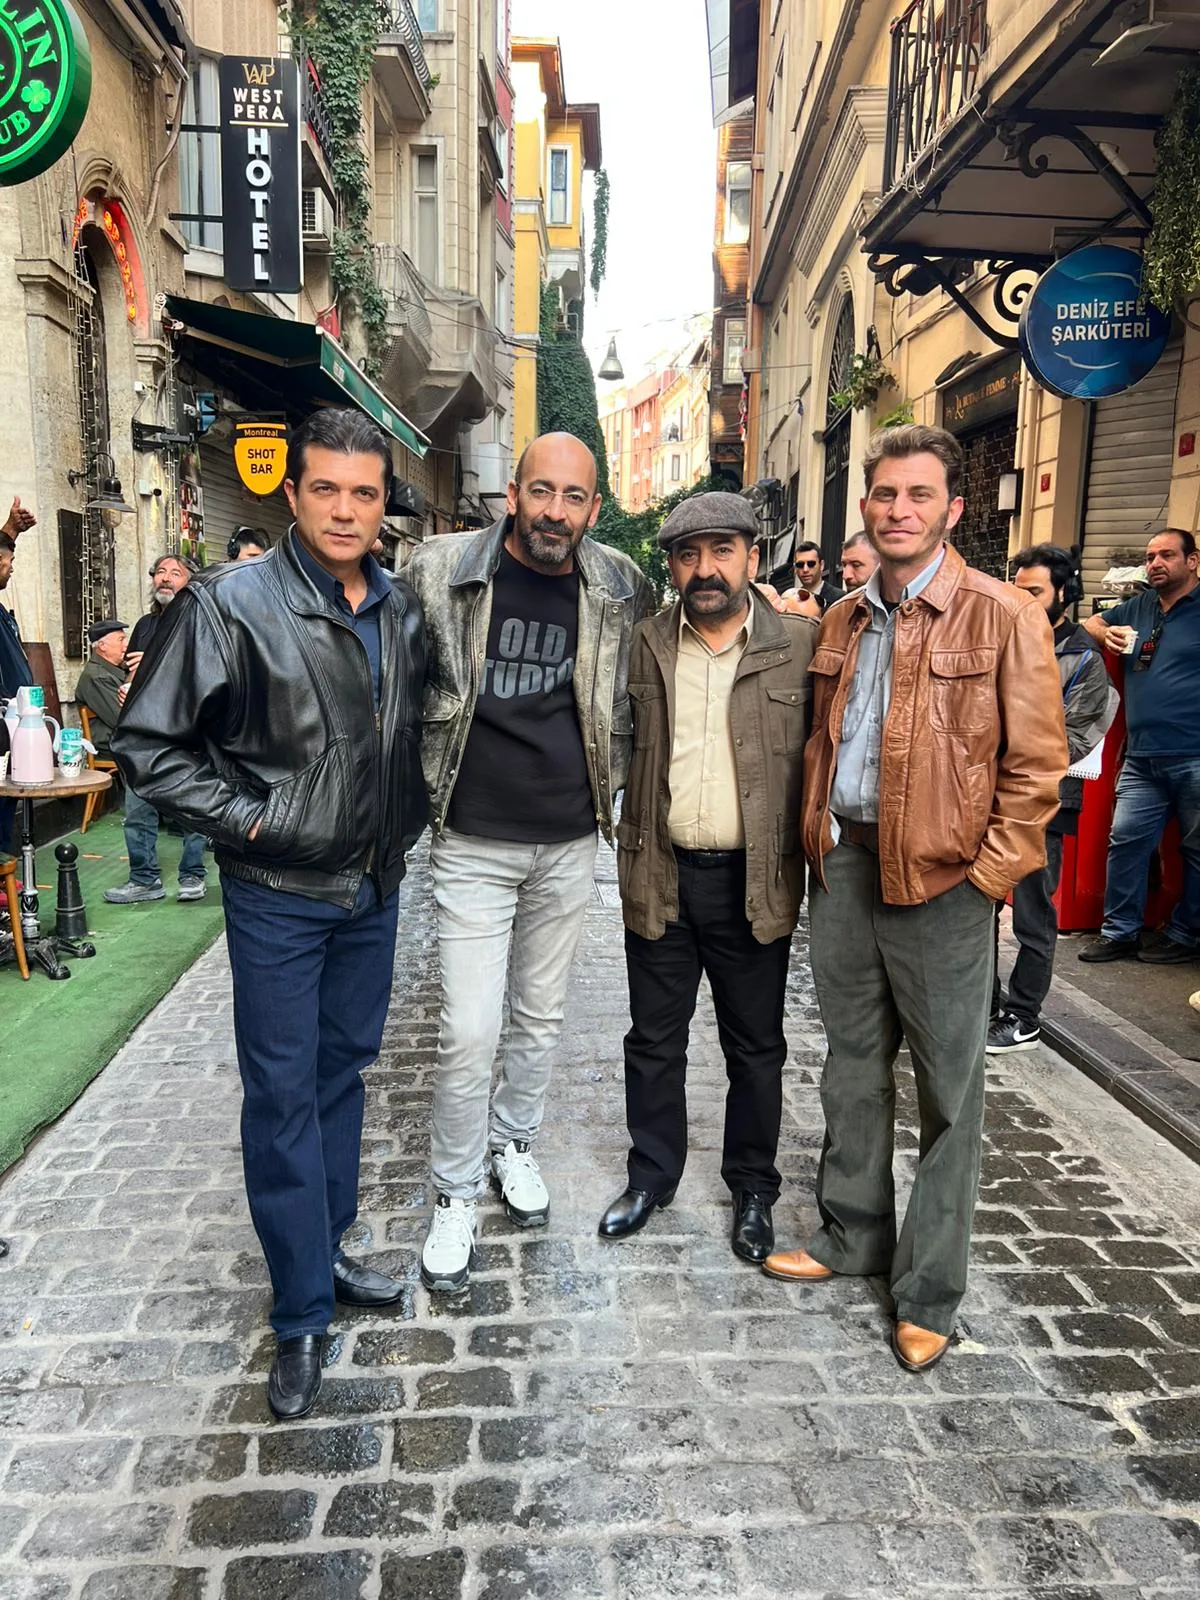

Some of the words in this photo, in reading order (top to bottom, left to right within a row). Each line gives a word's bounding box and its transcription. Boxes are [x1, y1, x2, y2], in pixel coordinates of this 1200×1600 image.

[232, 87, 284, 104] WEST
[233, 103, 285, 121] PERA
[245, 127, 272, 281] HOTEL
[1056, 298, 1109, 320] DENİZ
[1113, 300, 1146, 317] EFE
[1051, 318, 1151, 346] ŞARKÜTERİ
[244, 429, 279, 437] Montreal
[247, 448, 276, 460] SHOT
[250, 463, 273, 474] BAR
[498, 617, 567, 664] OLD
